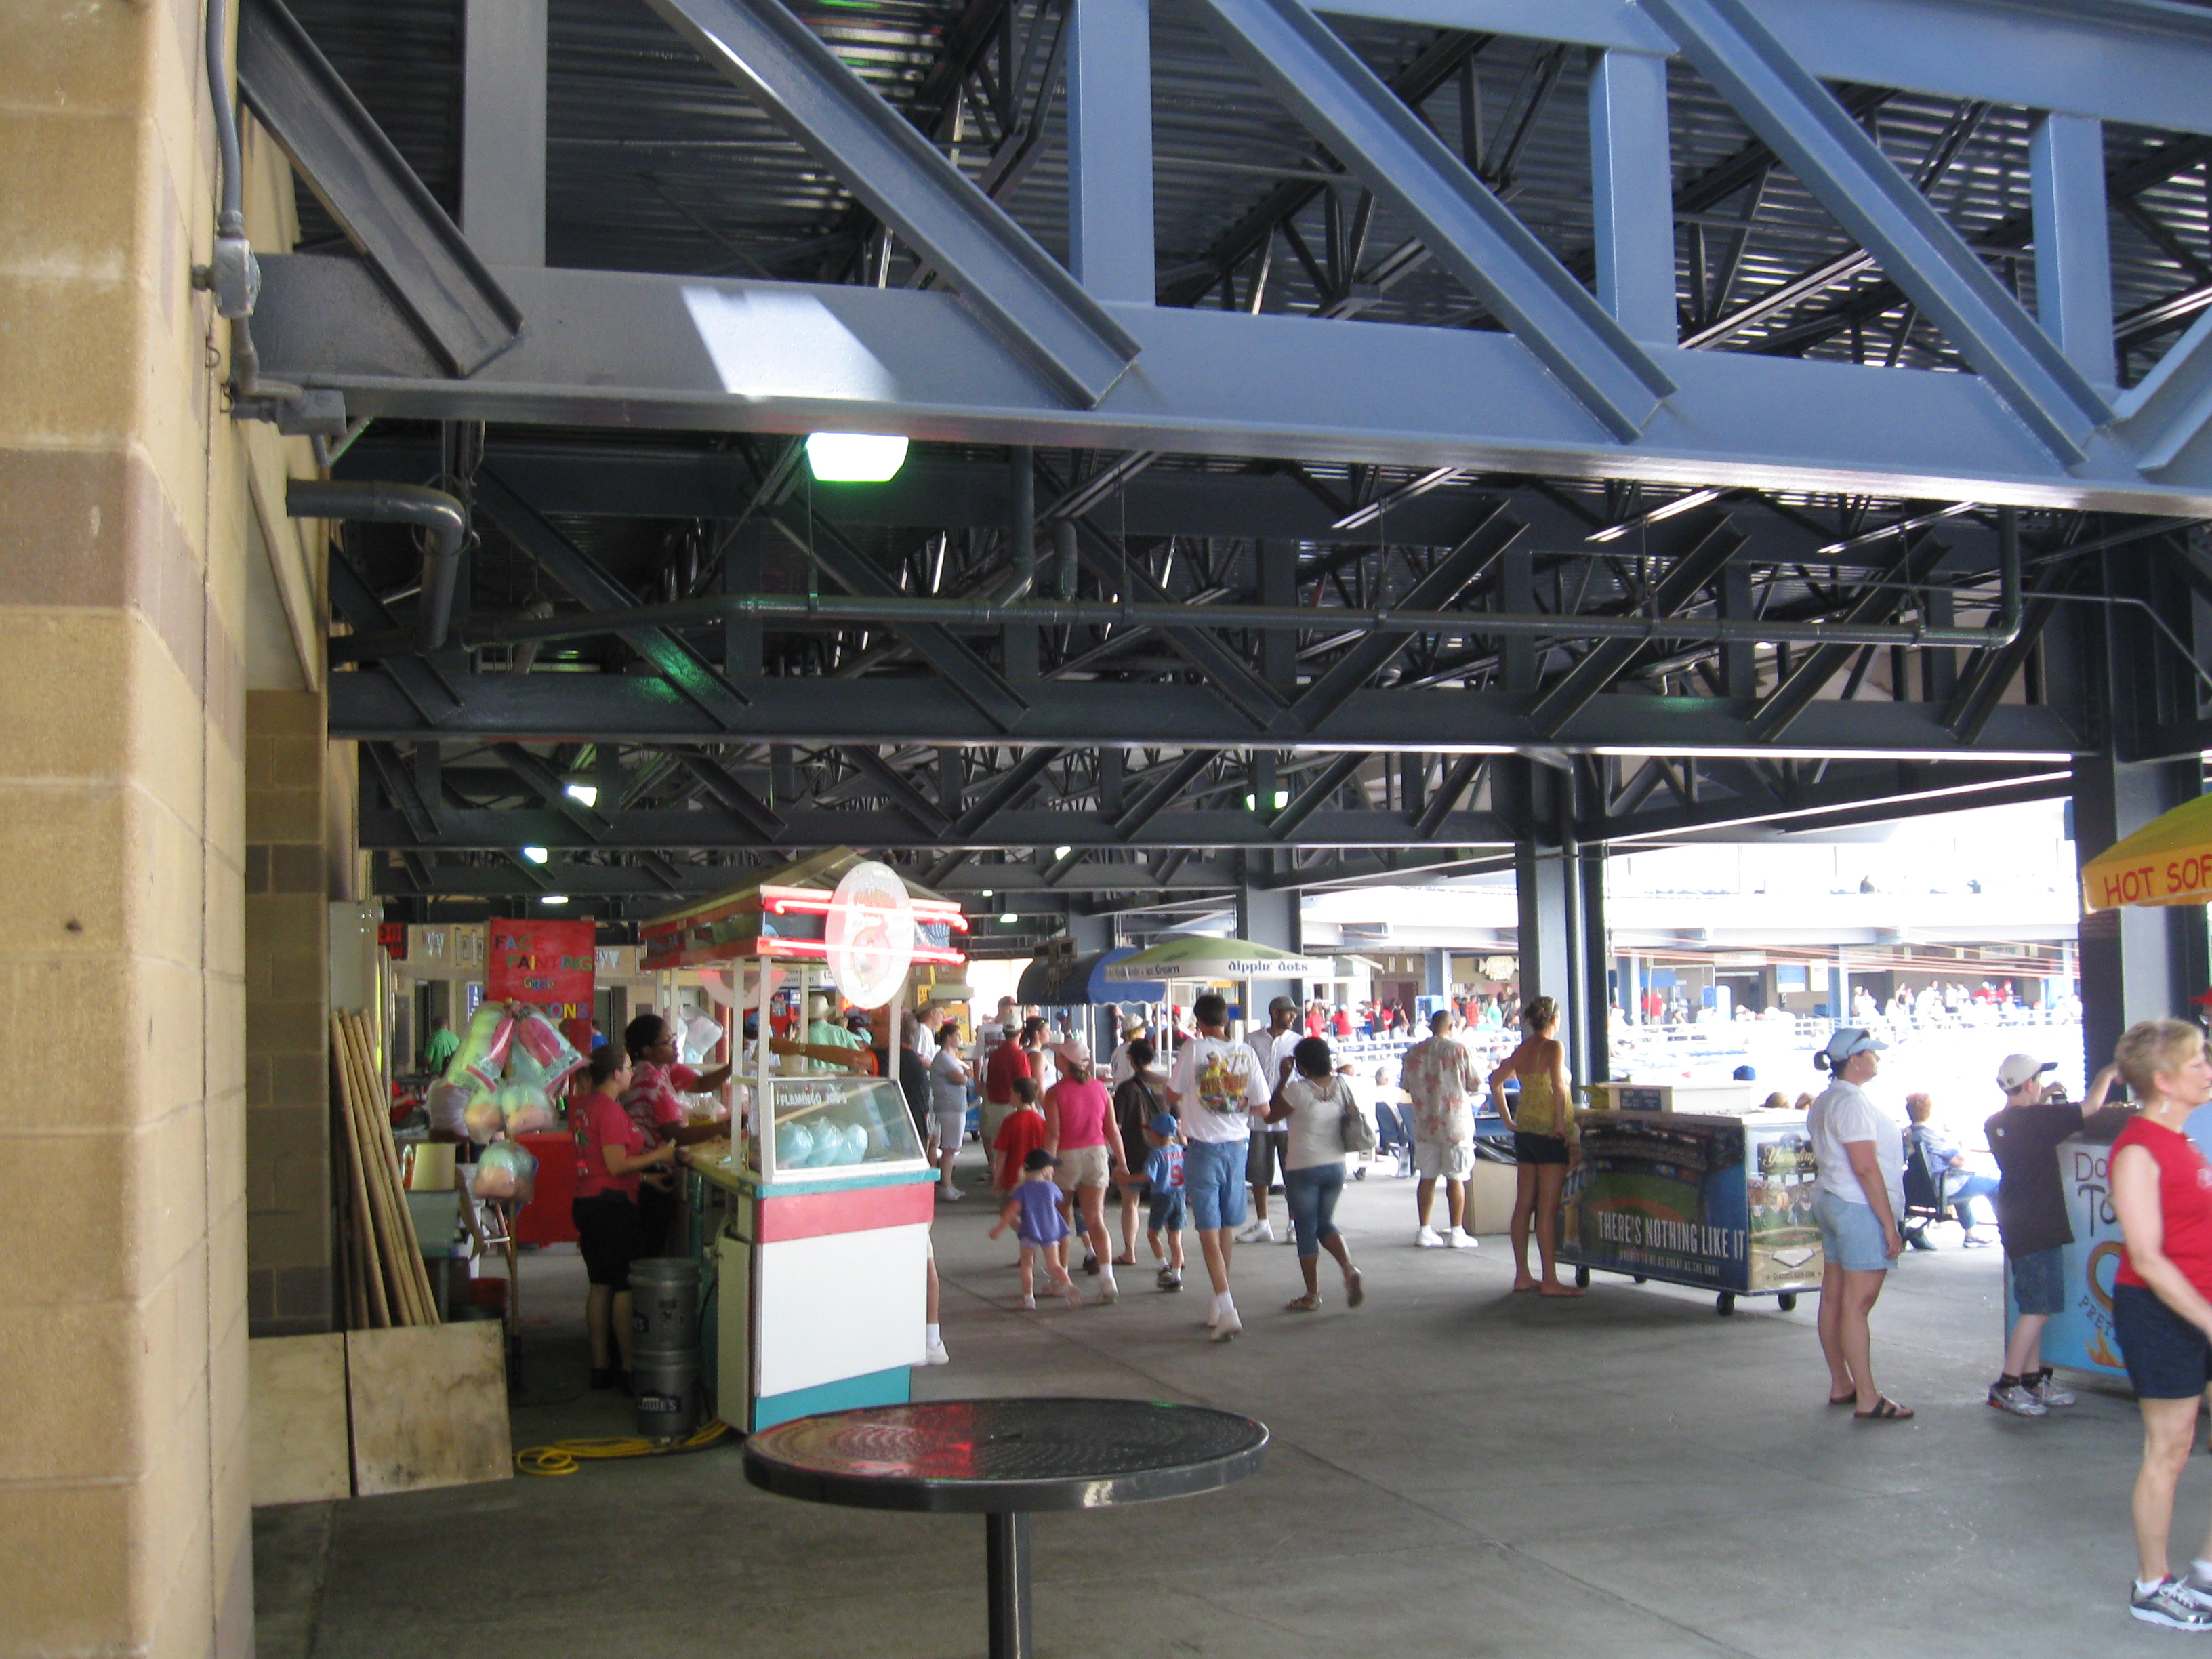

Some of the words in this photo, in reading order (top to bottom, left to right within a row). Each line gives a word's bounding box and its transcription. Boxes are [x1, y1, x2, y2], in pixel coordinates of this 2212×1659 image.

[2104, 867, 2154, 906] HOT
[2167, 854, 2212, 893] SOF
[495, 935, 546, 951] FACE
[506, 954, 593, 971] PAINTING
[1228, 960, 1273, 973] dippin'
[1277, 960, 1309, 972] dots
[779, 1092, 823, 1107] FLAMINGO
[1170, 1165, 1185, 1187] 9
[1597, 1211, 1642, 1245] THERE'S
[1645, 1218, 1698, 1254] NOTHING
[1702, 1225, 1730, 1258] LIKE
[1733, 1229, 1746, 1261] IT
